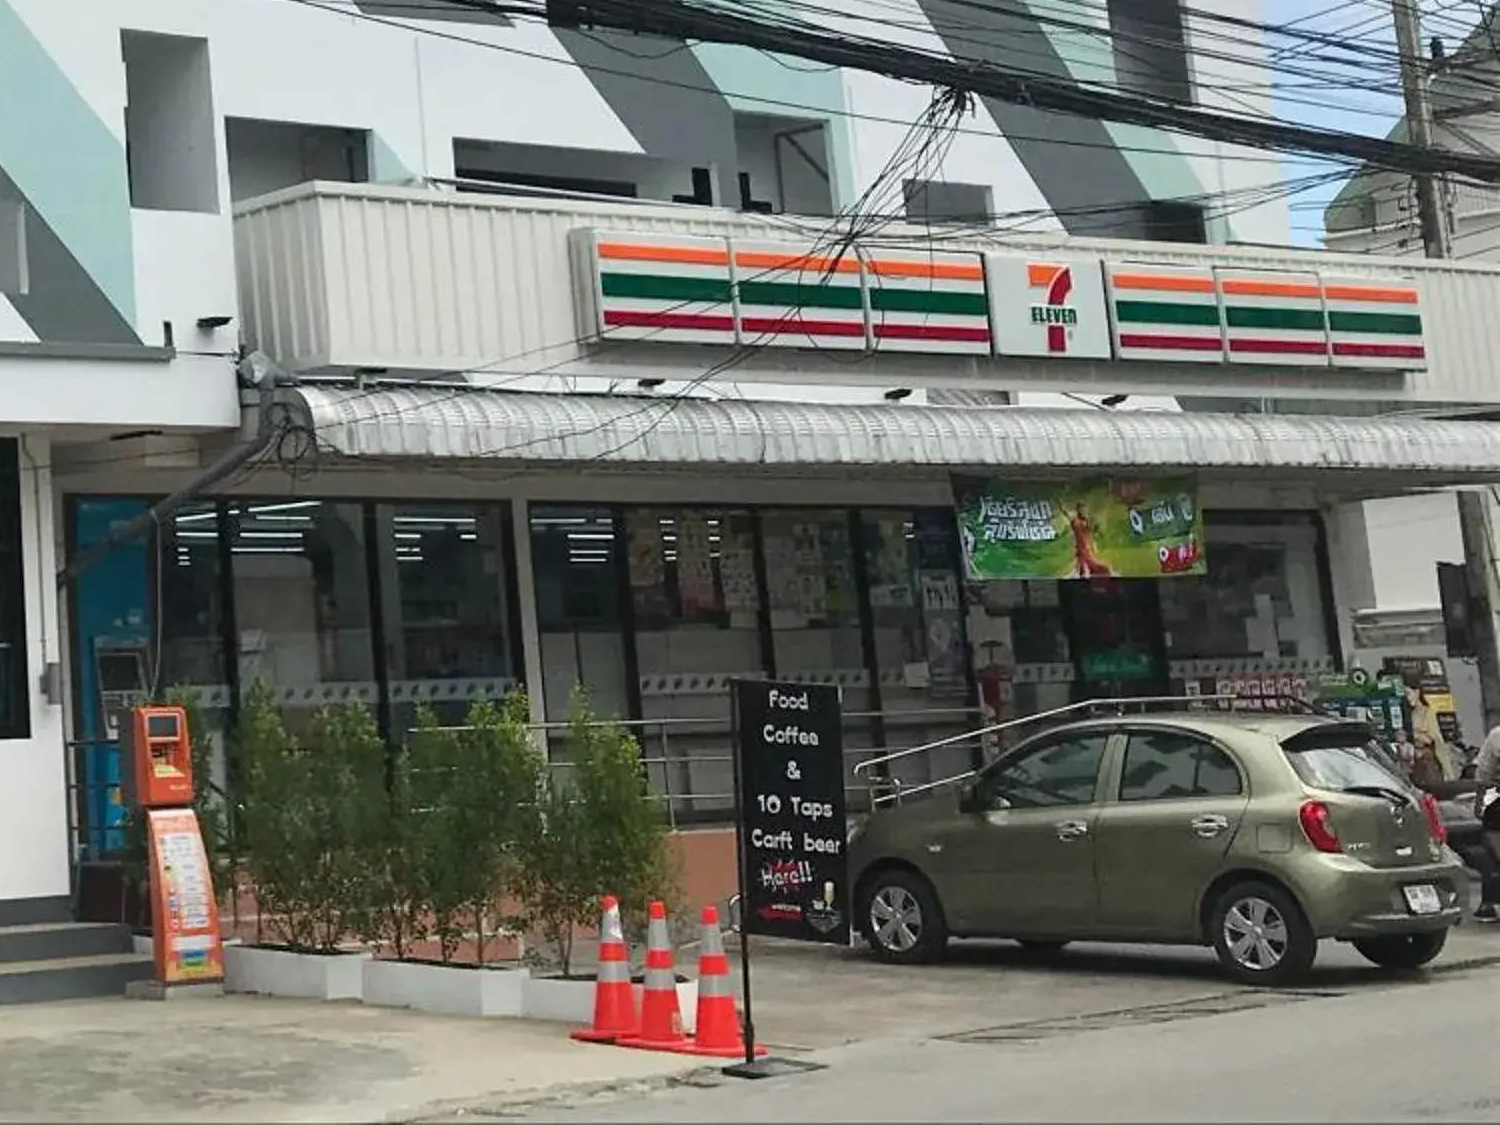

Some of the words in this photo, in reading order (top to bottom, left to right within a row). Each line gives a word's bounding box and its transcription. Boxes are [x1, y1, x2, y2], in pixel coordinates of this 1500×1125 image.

[1027, 263, 1073, 353] 7
[768, 689, 809, 710] Food
[763, 723, 819, 746] Coffee
[786, 760, 801, 780] &
[757, 794, 781, 815] 10
[790, 795, 833, 823] Taps
[751, 828, 793, 851] Carft
[803, 832, 841, 855] beer
